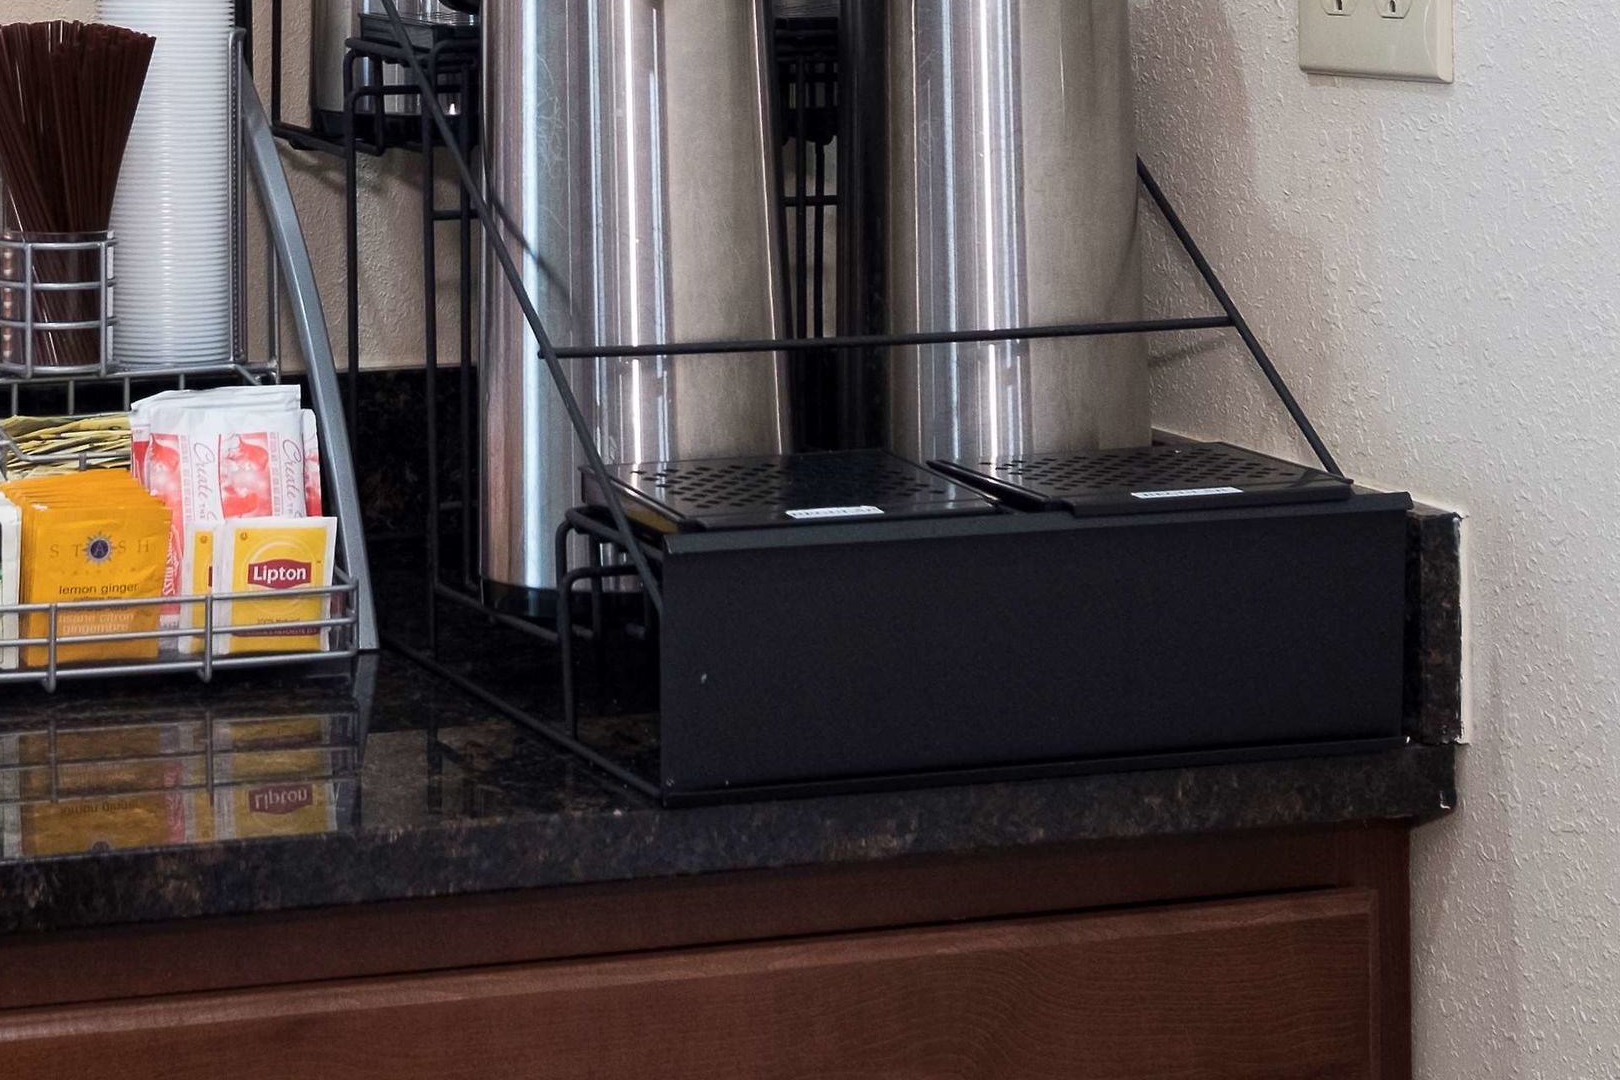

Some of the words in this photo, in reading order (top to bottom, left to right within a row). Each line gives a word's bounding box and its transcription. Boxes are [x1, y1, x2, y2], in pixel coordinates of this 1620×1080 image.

[252, 564, 307, 584] Lipton
[59, 585, 97, 595] lemon
[101, 583, 140, 595] ginger
